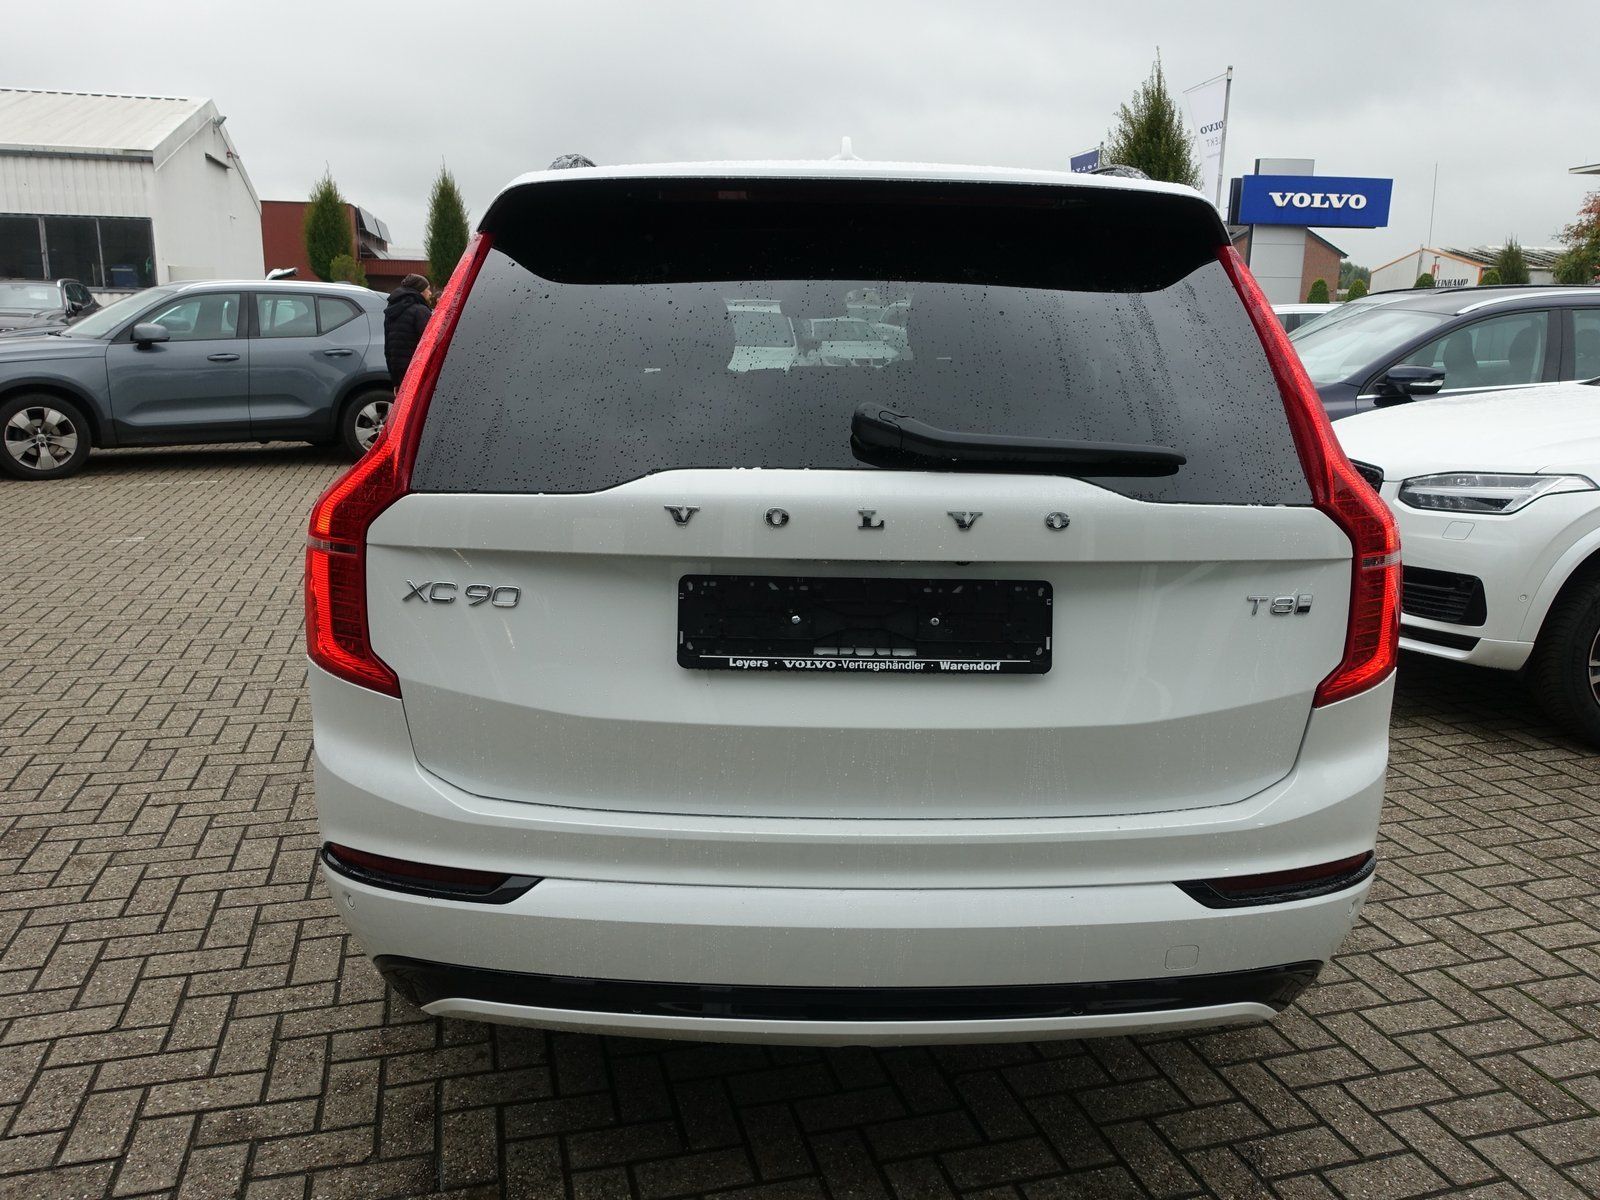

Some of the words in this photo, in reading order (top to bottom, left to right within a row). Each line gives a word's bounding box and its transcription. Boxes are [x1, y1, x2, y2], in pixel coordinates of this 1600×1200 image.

[1268, 192, 1367, 210] VOLVO
[663, 505, 1070, 531] VOLVO
[729, 657, 769, 669] Leyers
[940, 661, 1000, 671] Warendorf
